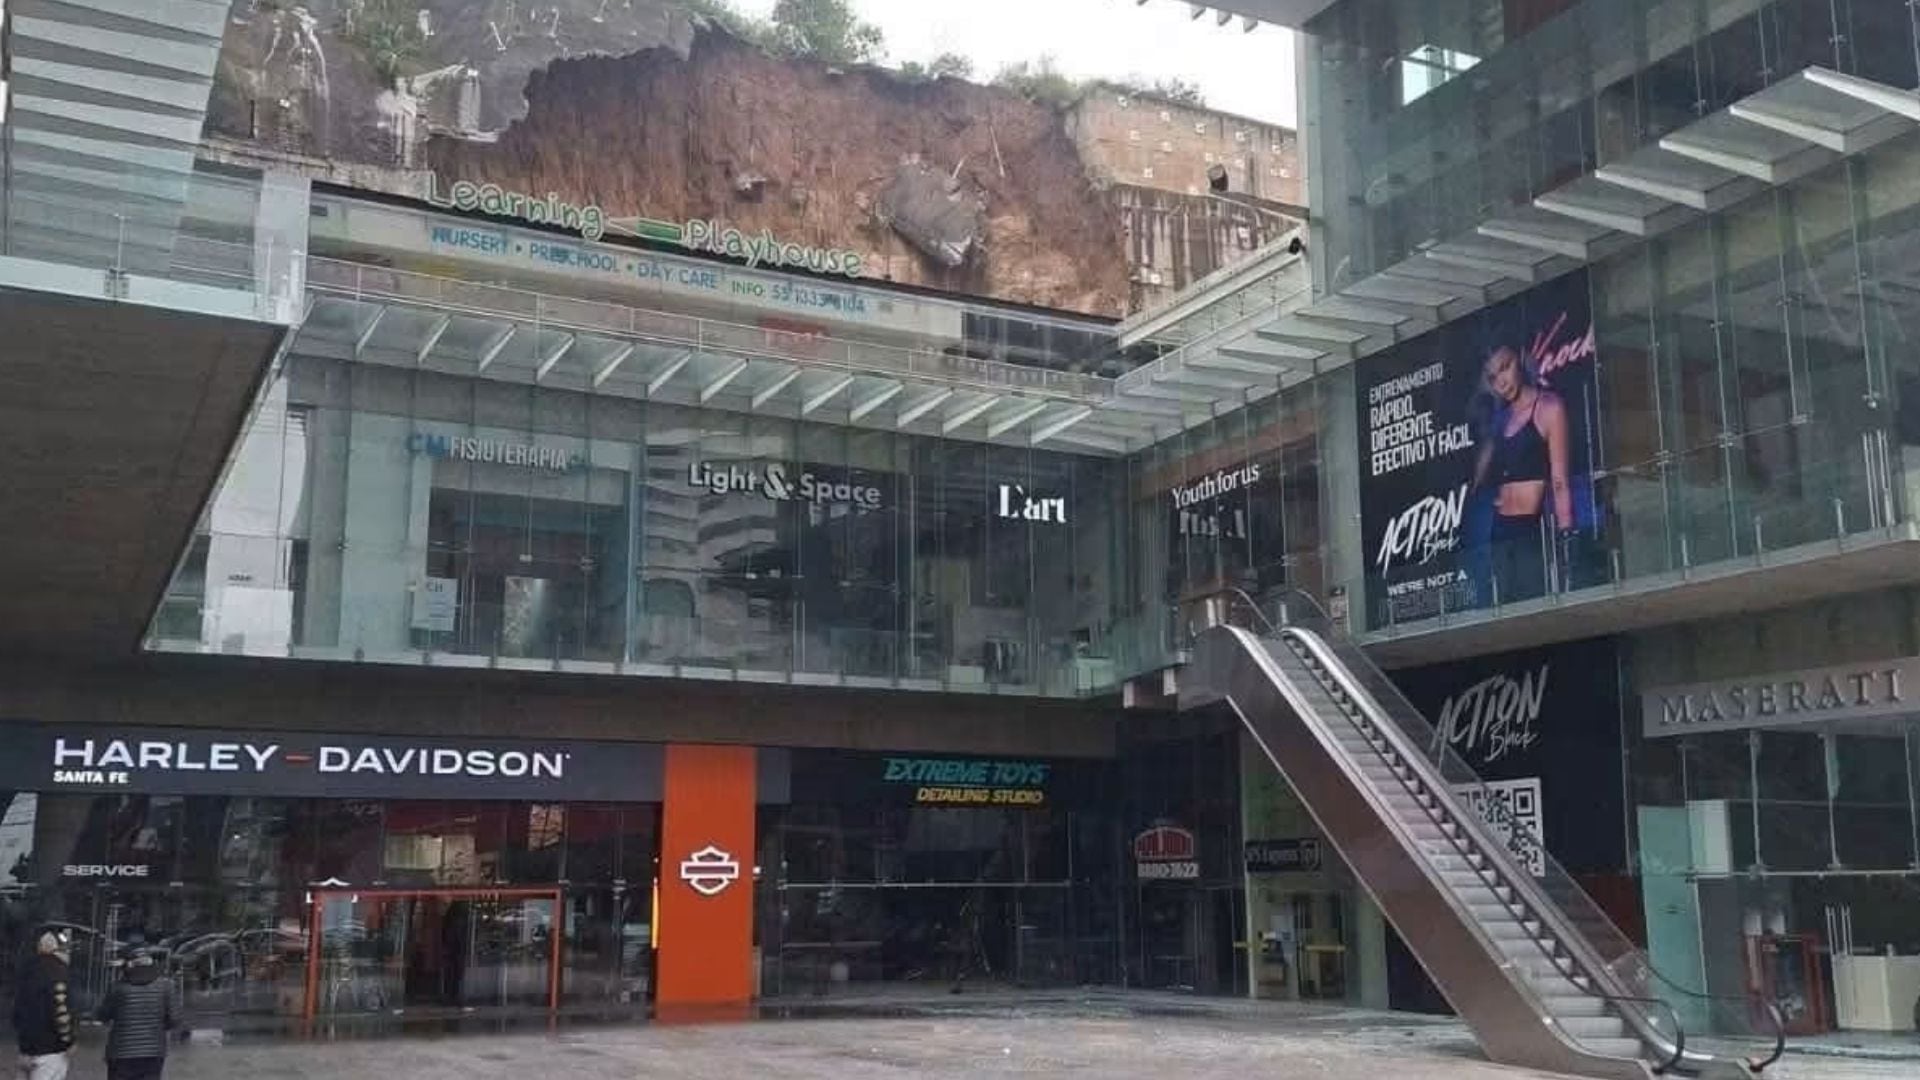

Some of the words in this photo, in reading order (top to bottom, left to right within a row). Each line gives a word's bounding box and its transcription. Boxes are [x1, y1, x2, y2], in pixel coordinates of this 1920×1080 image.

[424, 169, 604, 241] Learning
[686, 219, 862, 277] Playhouse
[432, 227, 508, 253] NURSERY
[530, 242, 619, 273] PRESCHOOL
[637, 261, 673, 282] DAY
[678, 268, 717, 290] CARE
[1369, 362, 1443, 405] ENTRENAMIENTO
[1371, 410, 1433, 453] DIFERENTE
[1372, 439, 1426, 476] EFECTIVO
[1427, 434, 1437, 458] Y
[1438, 423, 1475, 456] FÁCIL
[689, 462, 757, 494] Light
[763, 463, 794, 500] &
[799, 473, 882, 504] Space
[1171, 474, 1215, 510] Youth
[1216, 469, 1240, 494] for
[1240, 461, 1259, 486] us
[1427, 571, 1456, 588] NOT
[1457, 568, 1468, 580] A
[1660, 668, 1902, 726] MASERATI
[53, 738, 281, 772] HARLEY
[318, 746, 563, 778] DAVIDSON
[53, 771, 104, 783] SANTA
[109, 772, 129, 784] FE
[882, 757, 990, 783] EXTREME
[991, 761, 1050, 784] TOYS
[915, 787, 990, 802] DETAILING
[992, 789, 1044, 804] STUDIO
[63, 864, 149, 877] SERVICE
